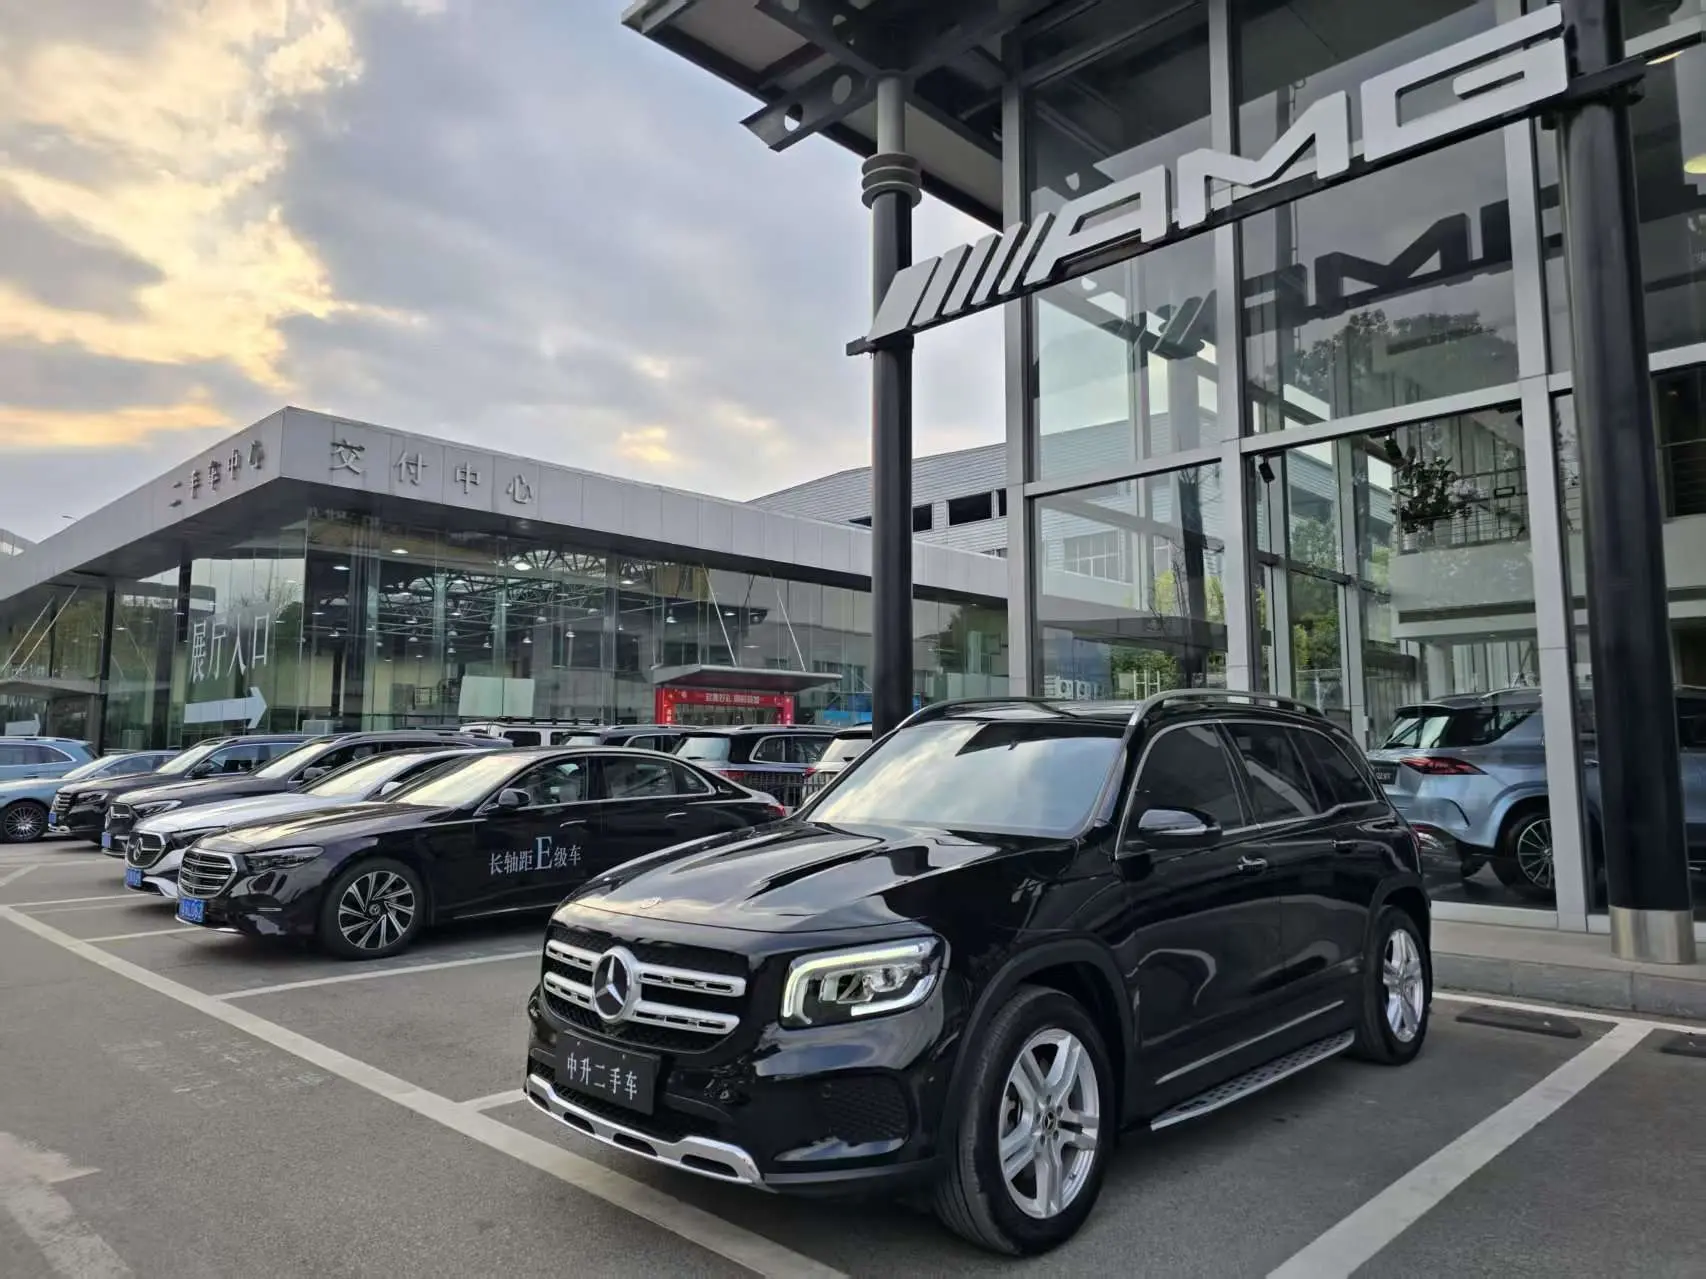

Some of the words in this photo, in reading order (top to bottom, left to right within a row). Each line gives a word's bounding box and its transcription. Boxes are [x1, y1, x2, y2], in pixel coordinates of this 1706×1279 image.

[1023, 3, 1568, 284] AMG
[169, 440, 264, 508] 二手车中心
[330, 440, 532, 504] 交付中心
[189, 612, 270, 684] 展厅入口
[489, 836, 581, 875] 长轴距E级车
[567, 1052, 637, 1101] 中升二手车
